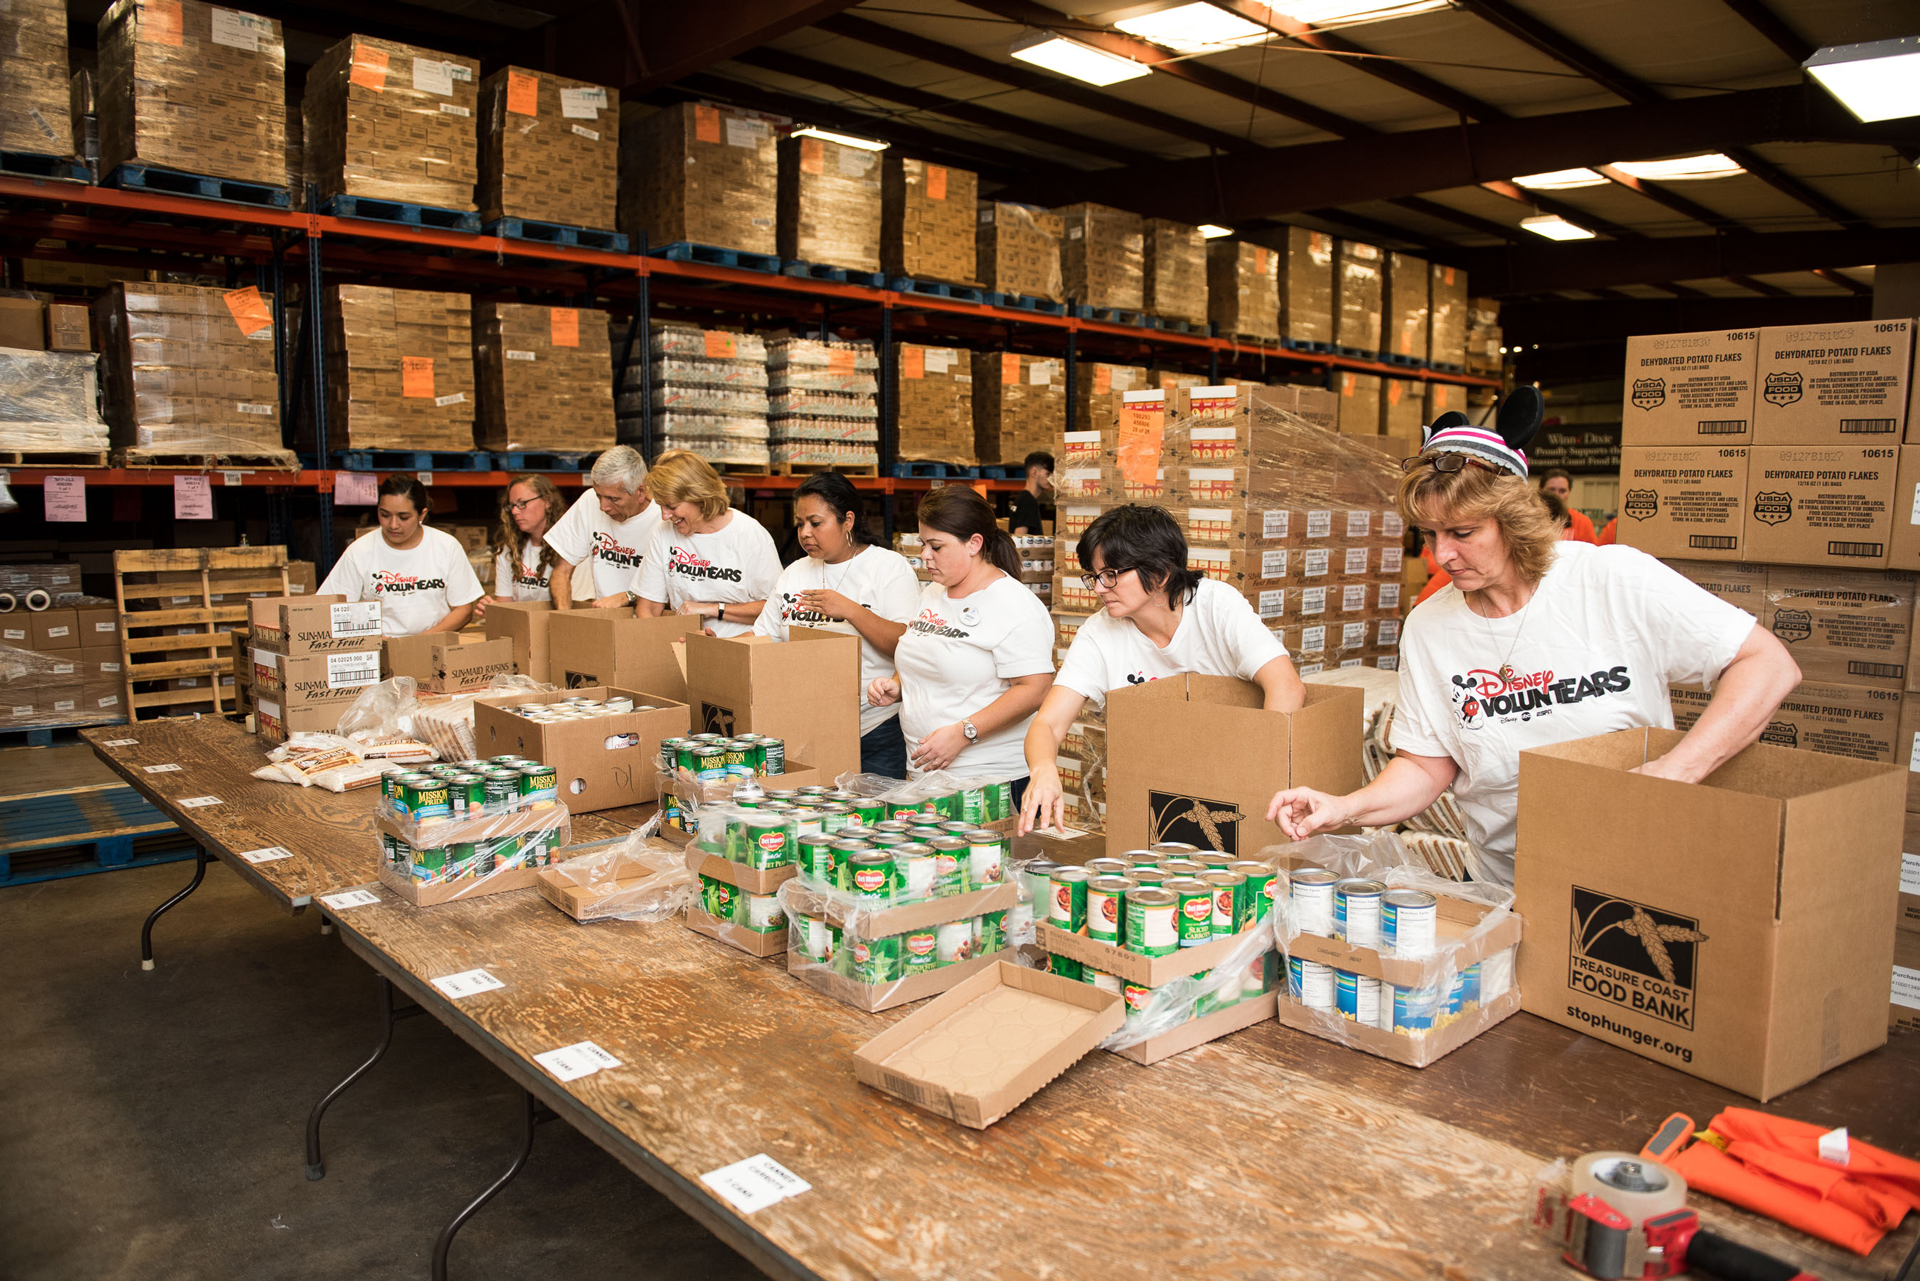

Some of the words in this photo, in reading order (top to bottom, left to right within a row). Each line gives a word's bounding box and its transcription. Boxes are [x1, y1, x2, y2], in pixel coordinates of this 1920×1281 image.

[1873, 323, 1907, 333] 10615
[1726, 332, 1755, 341] 10615
[1774, 349, 1826, 359] DEHYDRATED
[1827, 347, 1859, 357] POTATO
[1860, 345, 1892, 356] FLAKES
[1640, 356, 1685, 367] DEHYDRATED
[1686, 354, 1714, 364] POTATO
[1714, 352, 1742, 362] FLAKES
[1635, 381, 1662, 389] USDA
[1547, 433, 1576, 445] Winn
[1535, 446, 1567, 458] Proudly
[1569, 446, 1608, 457] Supports
[1718, 449, 1747, 457] 10615
[1861, 449, 1894, 458] 10615
[1562, 456, 1586, 466] Coast
[1587, 456, 1610, 466] Food
[1634, 469, 1678, 478] DEHYDRATED
[1678, 469, 1705, 478] POTATO
[1706, 469, 1733, 478] FLAKES
[1764, 470, 1815, 480] DEHYDRATED
[1816, 470, 1847, 480] POTATO
[1848, 471, 1879, 481] FLAKES
[599, 548, 644, 568] VOLUNTE
[675, 562, 742, 583] VOLUNTEARS
[1736, 564, 1764, 574] 10615
[384, 578, 445, 592] VOLUNTEARS
[516, 577, 550, 588] VOLUNTEA
[1724, 584, 1751, 593] FLAKES
[1784, 588, 1835, 600] DEHYDRATED
[1836, 591, 1867, 601] POTATO
[1777, 613, 1808, 621] USDA
[1777, 622, 1808, 630] FOOD
[298, 631, 332, 641] SUN-MA
[309, 639, 335, 650] Fast
[485, 662, 510, 674] RAISINS
[294, 680, 329, 692] SUN-MA
[417, 682, 432, 690] AISINS
[459, 675, 479, 686] Fast
[305, 689, 332, 700] Fast
[1479, 666, 1631, 718] VOLUNTEARS
[1867, 690, 1899, 701] 10615
[1779, 702, 1820, 714] HYDRATED
[1822, 706, 1852, 718] POTATO
[1854, 710, 1884, 721] FLAKES
[1763, 734, 1794, 743] FOOD
[700, 756, 726, 768] MISSION
[706, 762, 723, 770] PRIDE
[529, 774, 556, 789] MISSION
[418, 789, 447, 804] MISSION
[424, 798, 445, 806] PRIDE
[1187, 904, 1196, 912] Del
[1195, 903, 1211, 911] Monte
[1185, 931, 1211, 940] CARROTS
[920, 939, 935, 947] Monte
[1572, 955, 1639, 987] TREASURE
[1642, 978, 1689, 1003] COAST
[1571, 970, 1627, 1002] FOOD
[1632, 990, 1690, 1026] BANK
[1566, 1005, 1693, 1064] stophunger.org
